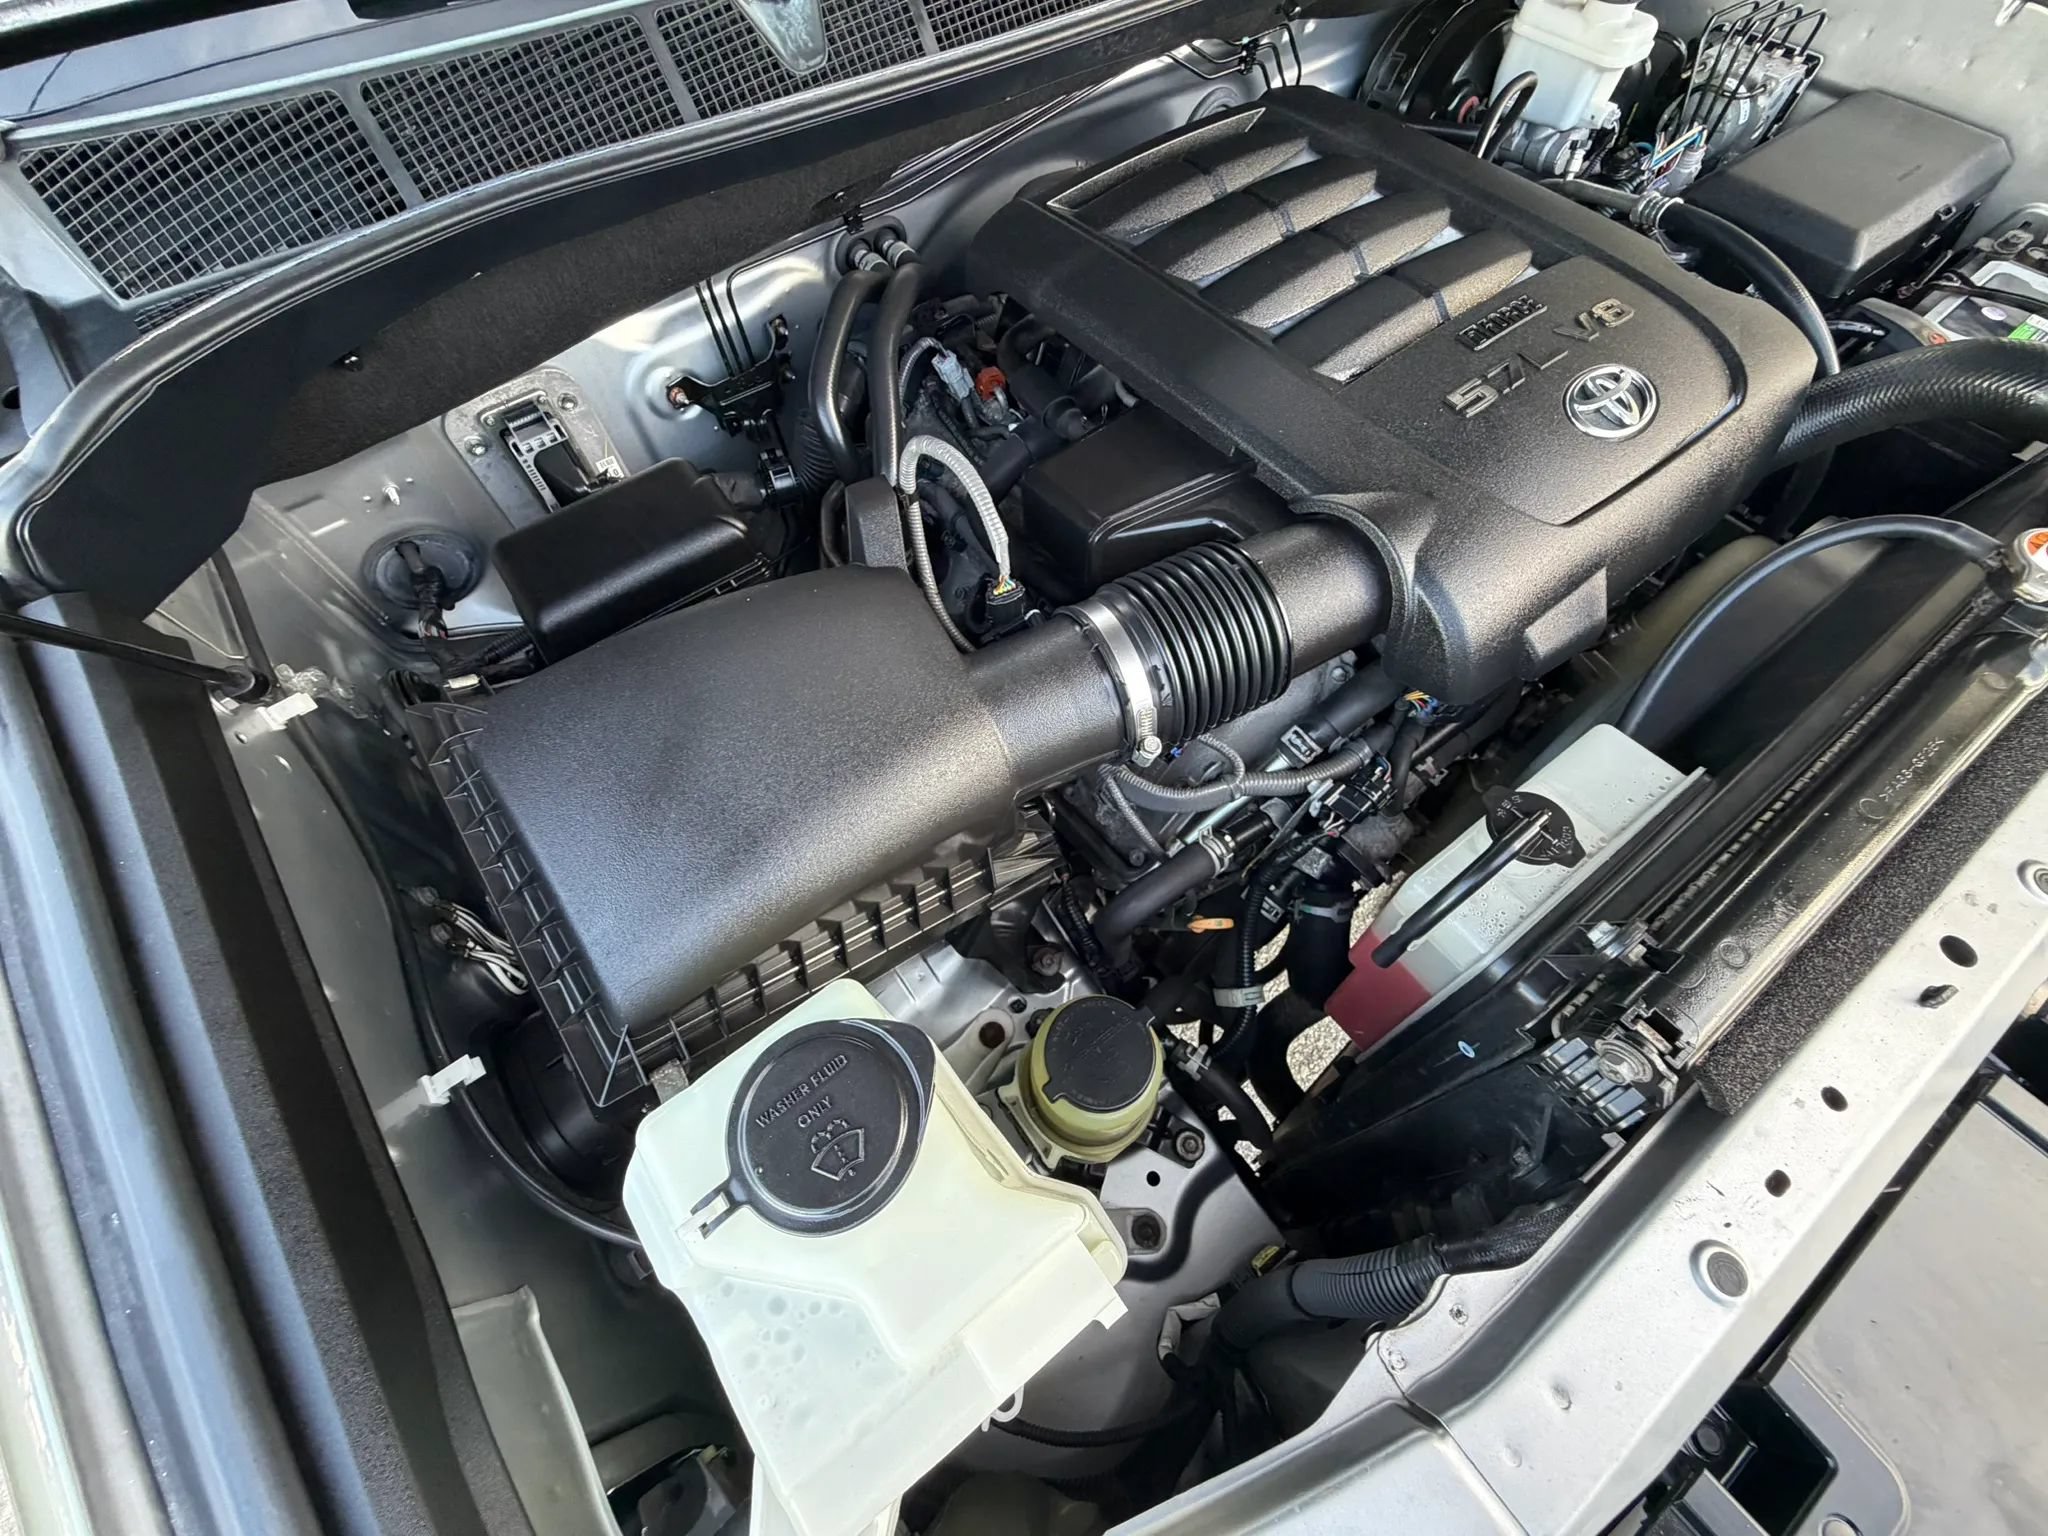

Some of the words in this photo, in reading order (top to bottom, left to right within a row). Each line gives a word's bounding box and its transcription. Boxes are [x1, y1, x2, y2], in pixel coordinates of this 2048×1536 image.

[1553, 298, 1635, 342] V8
[755, 1083, 811, 1128] WASHER
[810, 1054, 848, 1087] FLUID
[797, 1095, 832, 1128] ONLY
